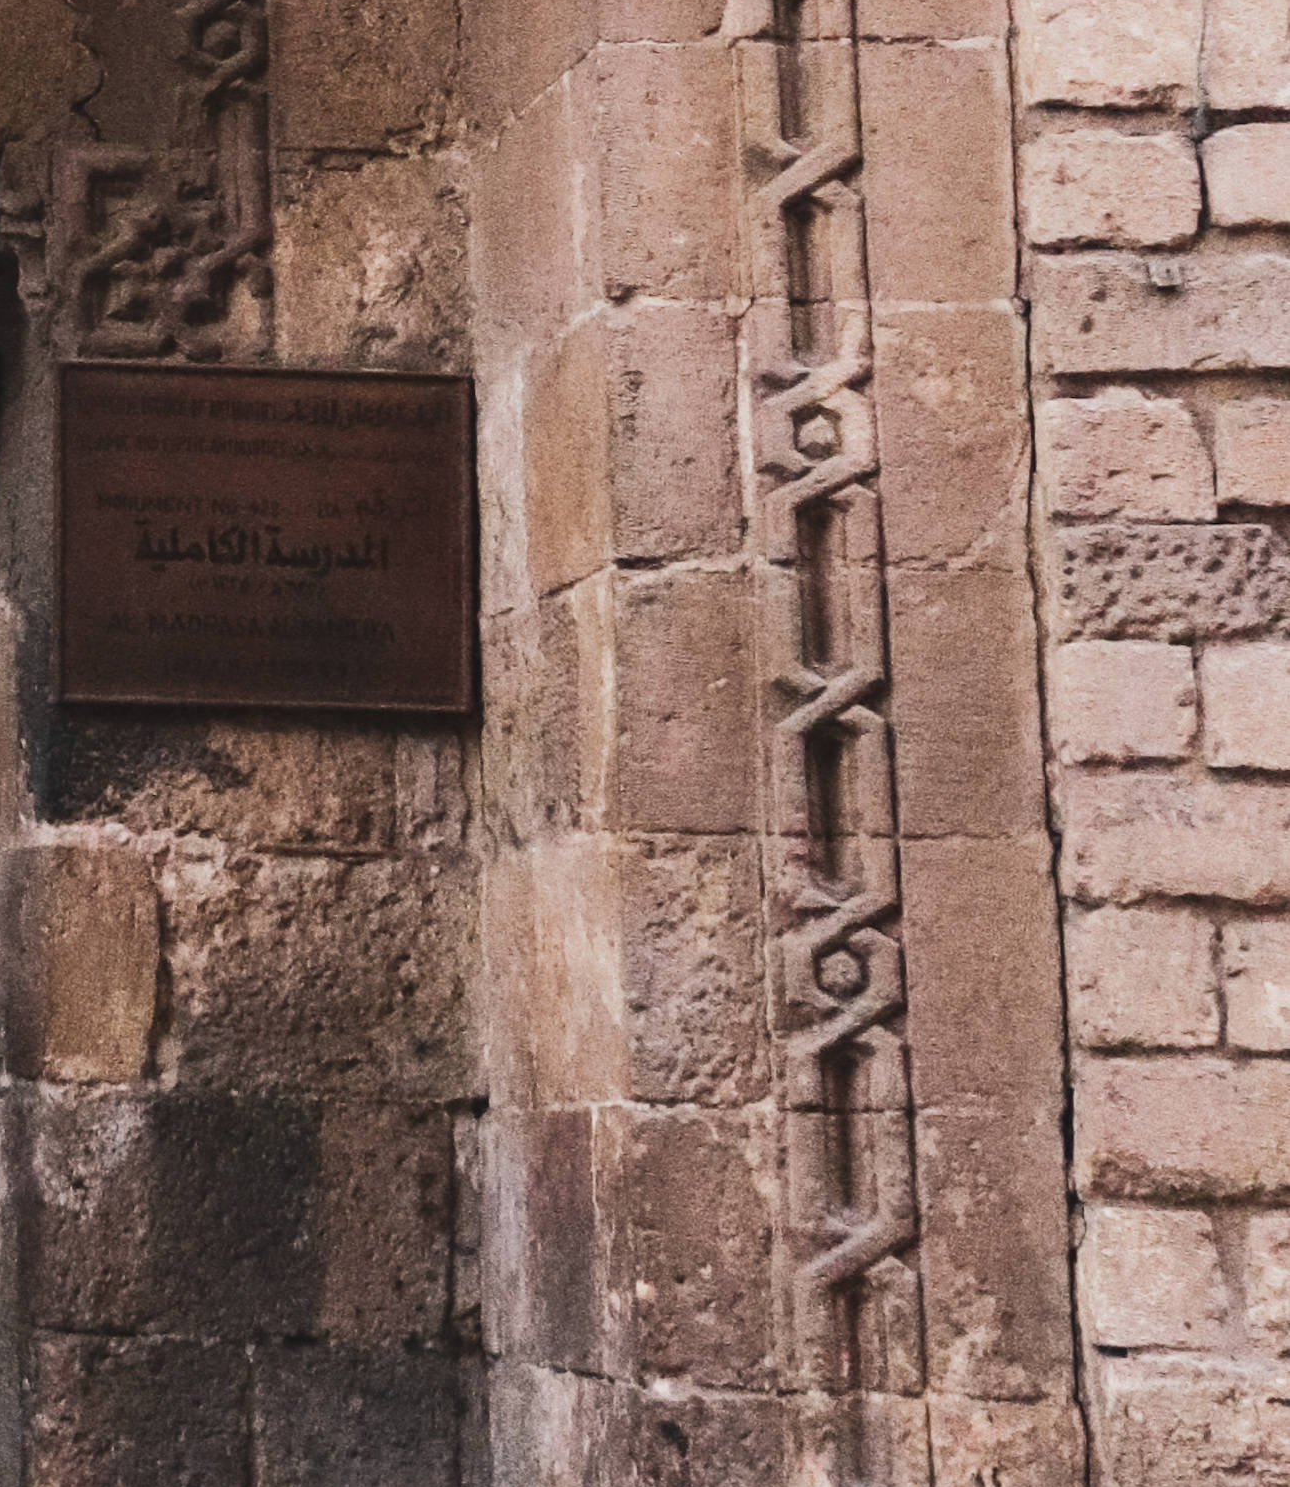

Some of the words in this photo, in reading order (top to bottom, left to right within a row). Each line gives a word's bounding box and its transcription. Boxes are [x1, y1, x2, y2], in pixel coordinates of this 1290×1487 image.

[96, 492, 203, 514] MONUMENT
[134, 519, 260, 572] الكاملية
[265, 525, 390, 577] المدرسة
[107, 612, 135, 633] AL
[149, 612, 263, 637] MADRASA
